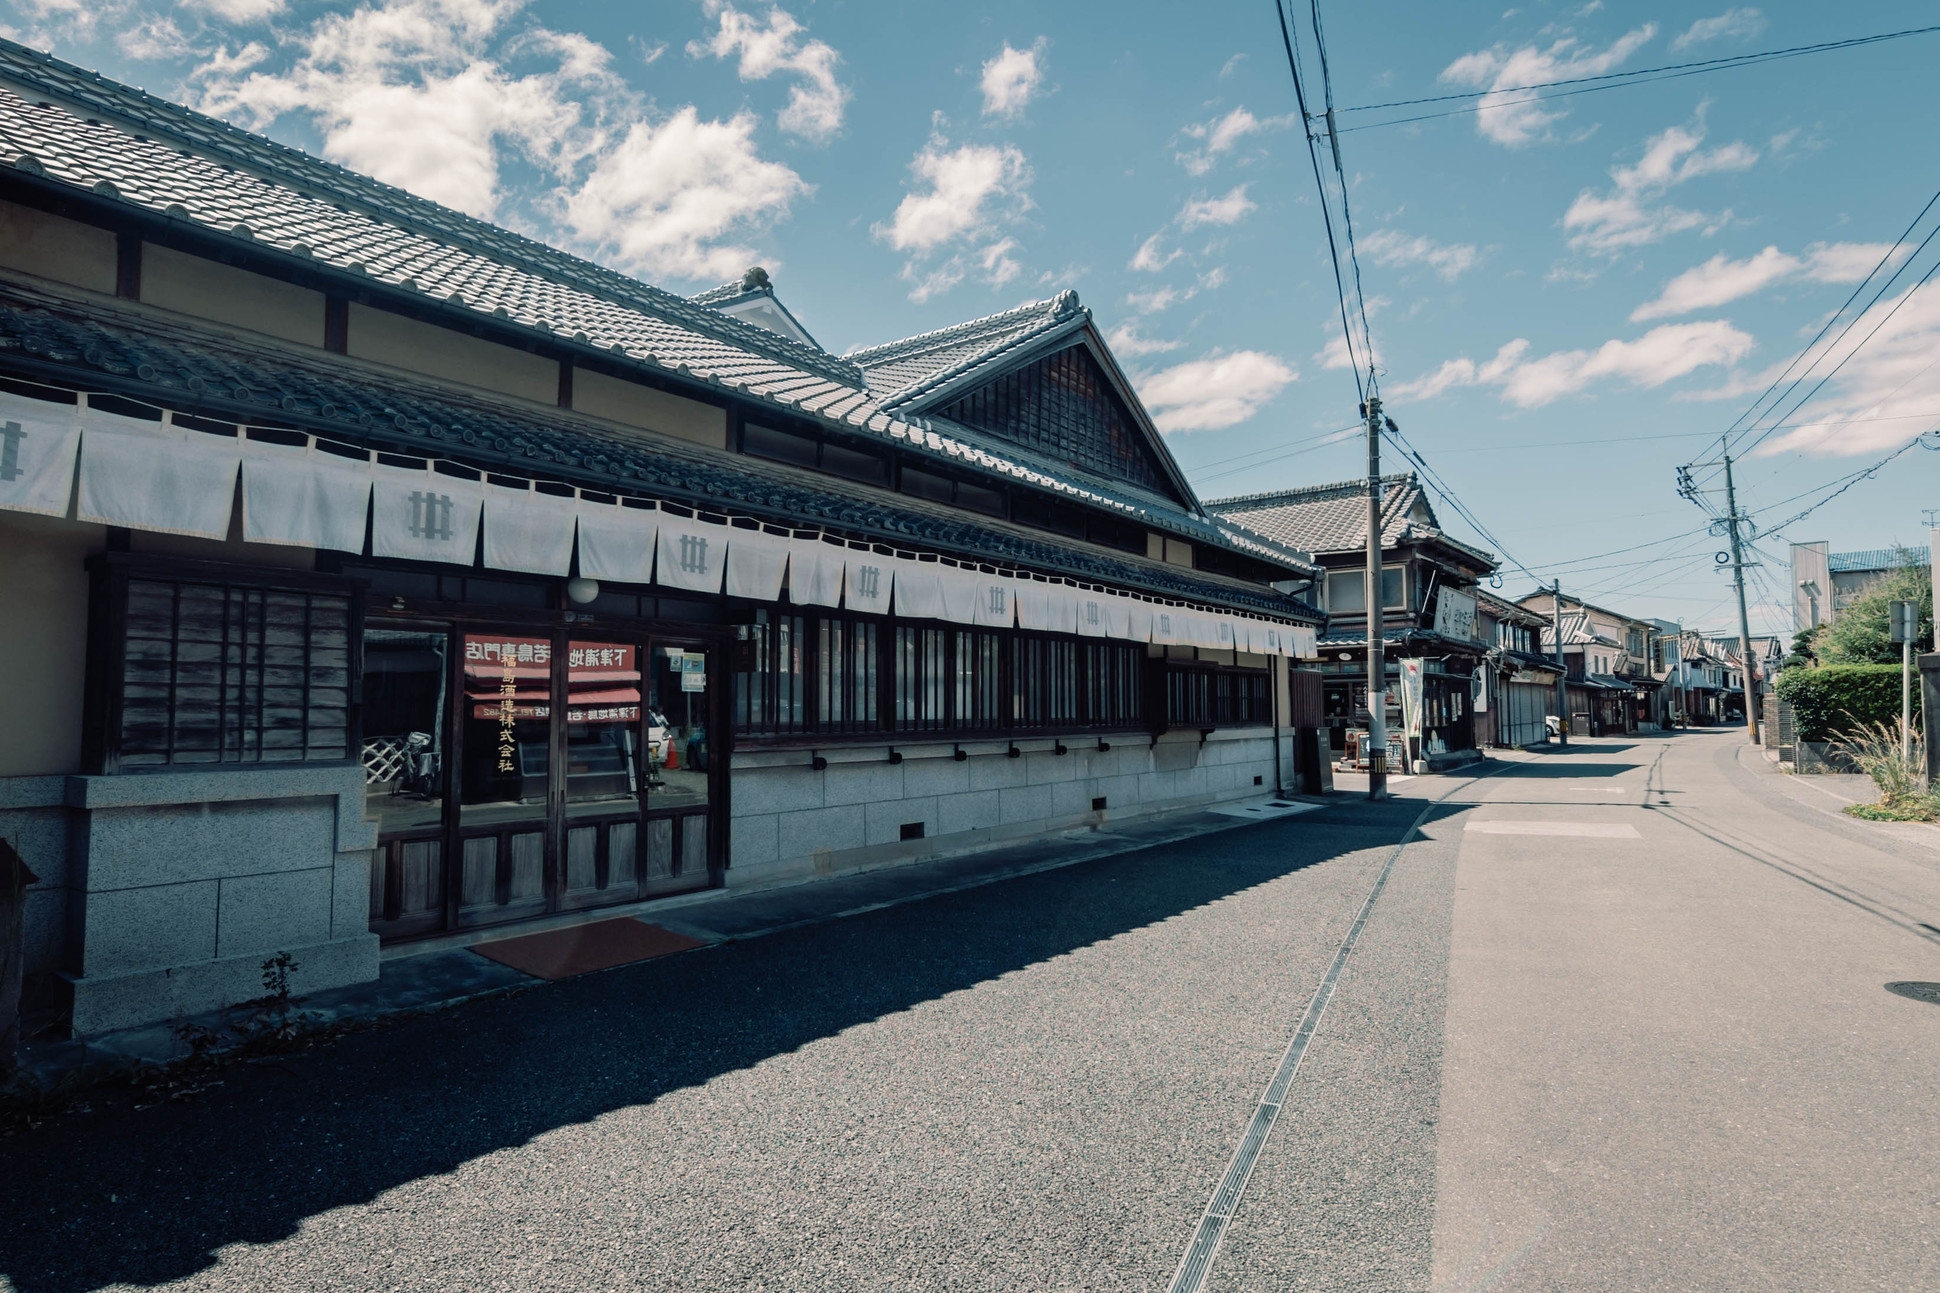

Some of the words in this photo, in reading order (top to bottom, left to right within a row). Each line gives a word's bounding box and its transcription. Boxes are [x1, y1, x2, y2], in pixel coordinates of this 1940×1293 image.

[498, 654, 517, 772] 福島酒造株式会社
